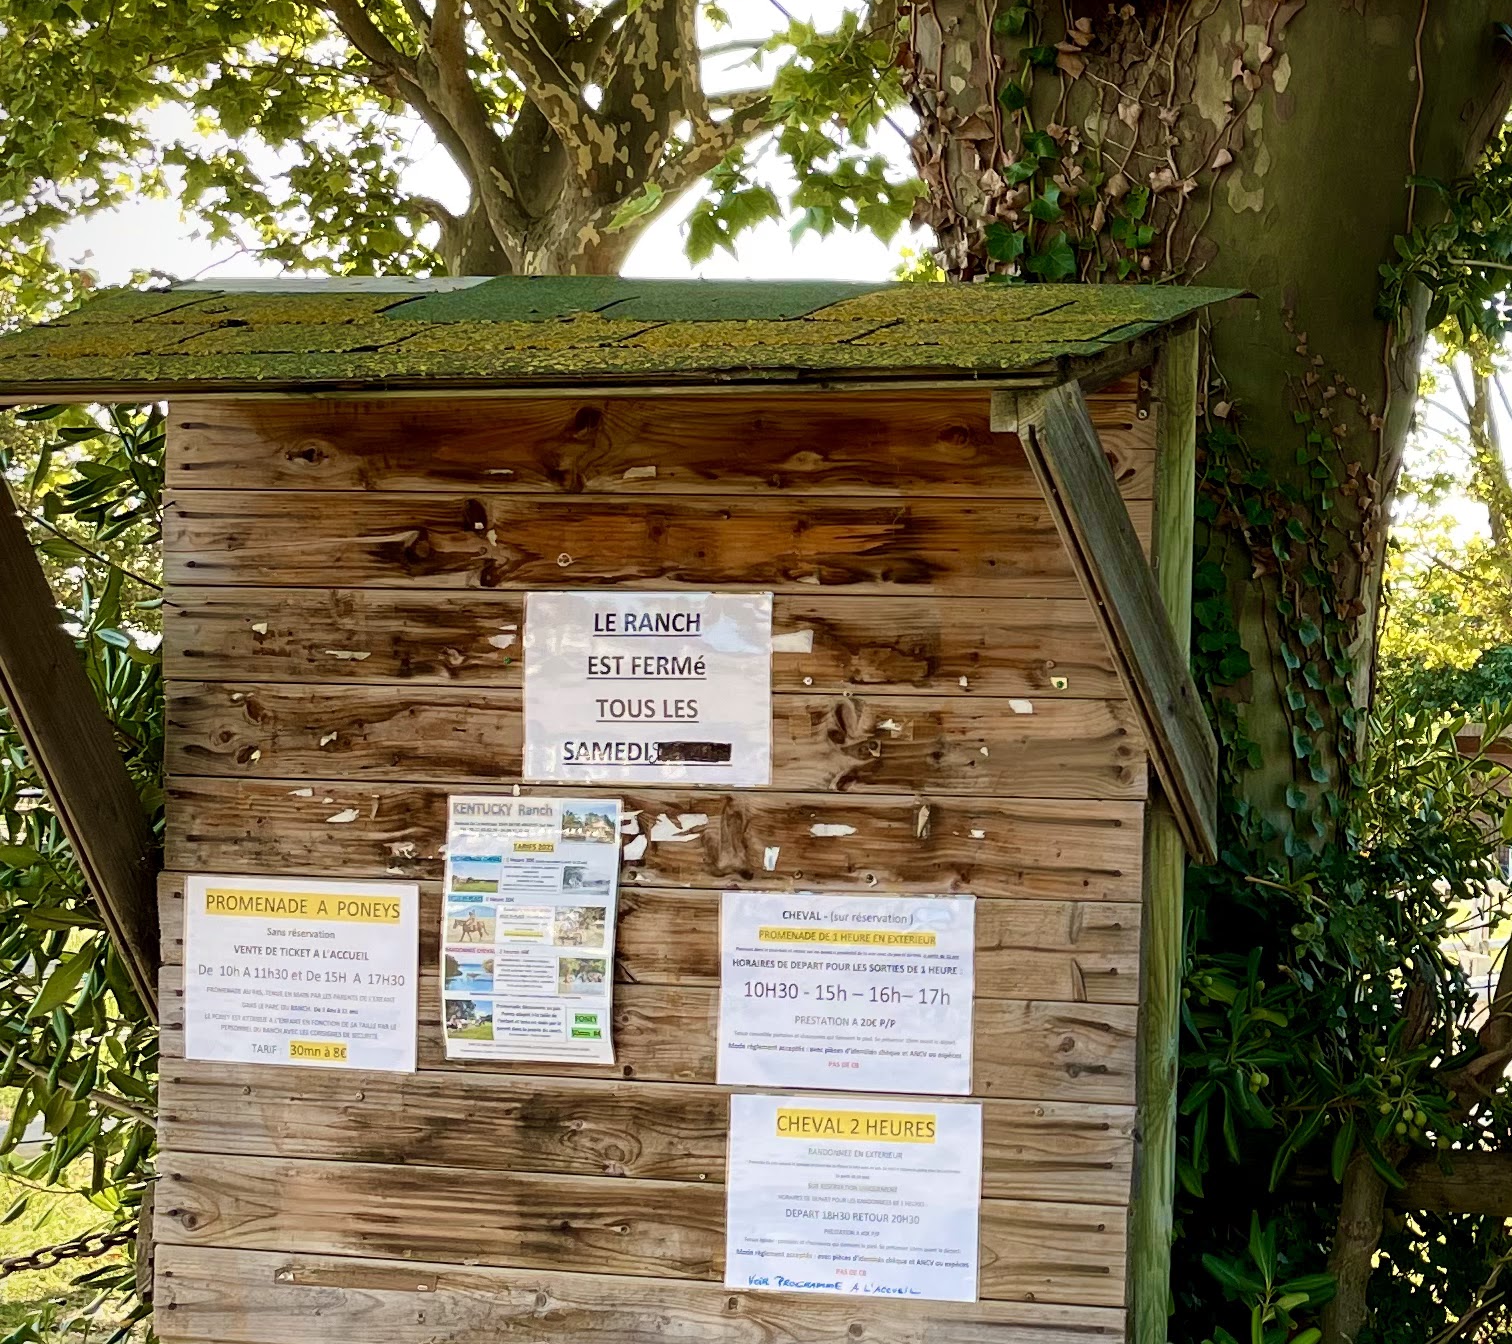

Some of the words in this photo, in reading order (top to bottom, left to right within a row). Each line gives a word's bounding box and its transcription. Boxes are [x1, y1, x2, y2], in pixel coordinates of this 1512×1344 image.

[594, 612, 617, 632] LE
[624, 612, 700, 632] RANCH
[587, 655, 624, 675] EST
[631, 655, 705, 675] FERMé
[594, 698, 656, 718] TOUS
[662, 698, 698, 718] LES
[452, 802, 512, 816] KENTUCKY
[517, 803, 553, 816] Ranch
[205, 894, 308, 914] PROMENADE
[315, 899, 328, 915] A
[336, 900, 400, 918] PONEYS
[781, 909, 821, 921] CHEVAL
[851, 913, 908, 924] réservation
[266, 927, 286, 936] Sans
[287, 928, 335, 938] réservation
[758, 929, 816, 941] PROMENADE
[818, 931, 830, 941] DE
[840, 932, 870, 942] HEURE
[872, 933, 885, 942] EN
[887, 934, 935, 944] EXTERIEUR
[233, 944, 262, 955] VENTE
[265, 946, 277, 956] DE
[279, 946, 311, 957] TICKET
[732, 958, 775, 968] HORAIRES
[776, 960, 788, 968] DE
[790, 960, 823, 969] DEPART
[825, 962, 850, 970] POUR
[852, 963, 867, 971] LES
[868, 963, 904, 973] SORTIES
[906, 965, 918, 973] DE
[928, 965, 957, 974] HEURE
[198, 963, 213, 976] De
[219, 964, 240, 977] 10h
[242, 965, 251, 978] A
[253, 967, 288, 980] 11h30
[290, 970, 303, 981] et
[305, 969, 321, 982] De
[324, 970, 347, 983] 15H
[352, 972, 361, 984] A
[367, 973, 405, 986] 17H30
[744, 981, 798, 999] 10H30
[815, 983, 847, 1001] 15h
[918, 987, 950, 1005] 17h
[794, 1015, 849, 1026] PRESTATION
[290, 1044, 321, 1056] 30mn
[332, 1046, 346, 1058] 8€
[776, 1114, 844, 1133] CHEVAL
[849, 1117, 859, 1134] 2
[865, 1118, 935, 1137] HEURES
[785, 1208, 819, 1218] DEPART
[821, 1210, 850, 1220] 18H30
[852, 1212, 888, 1222] RETOUR
[891, 1214, 919, 1224] 20H30
